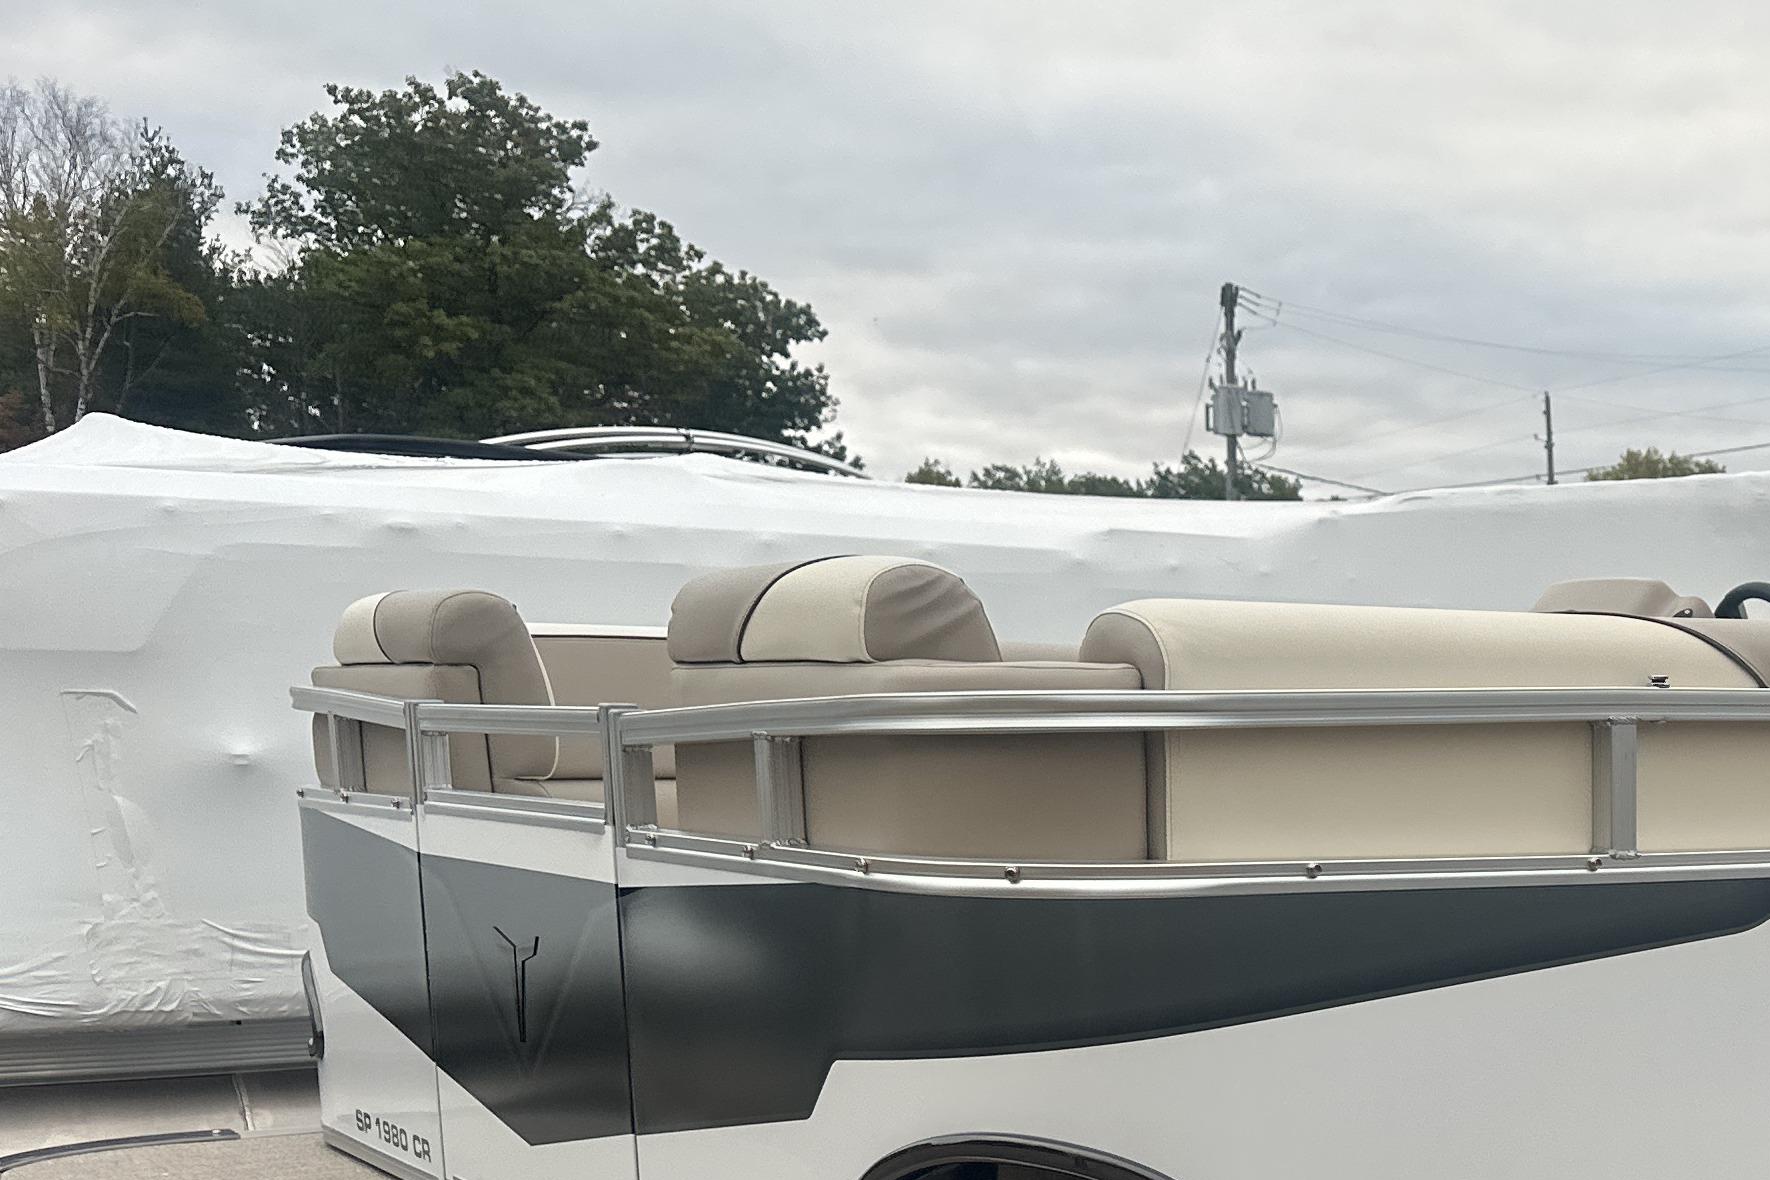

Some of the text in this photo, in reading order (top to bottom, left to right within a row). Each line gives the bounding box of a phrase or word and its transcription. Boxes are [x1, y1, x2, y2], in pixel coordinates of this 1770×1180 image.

[355, 1109, 432, 1163] SP 1980 CR
